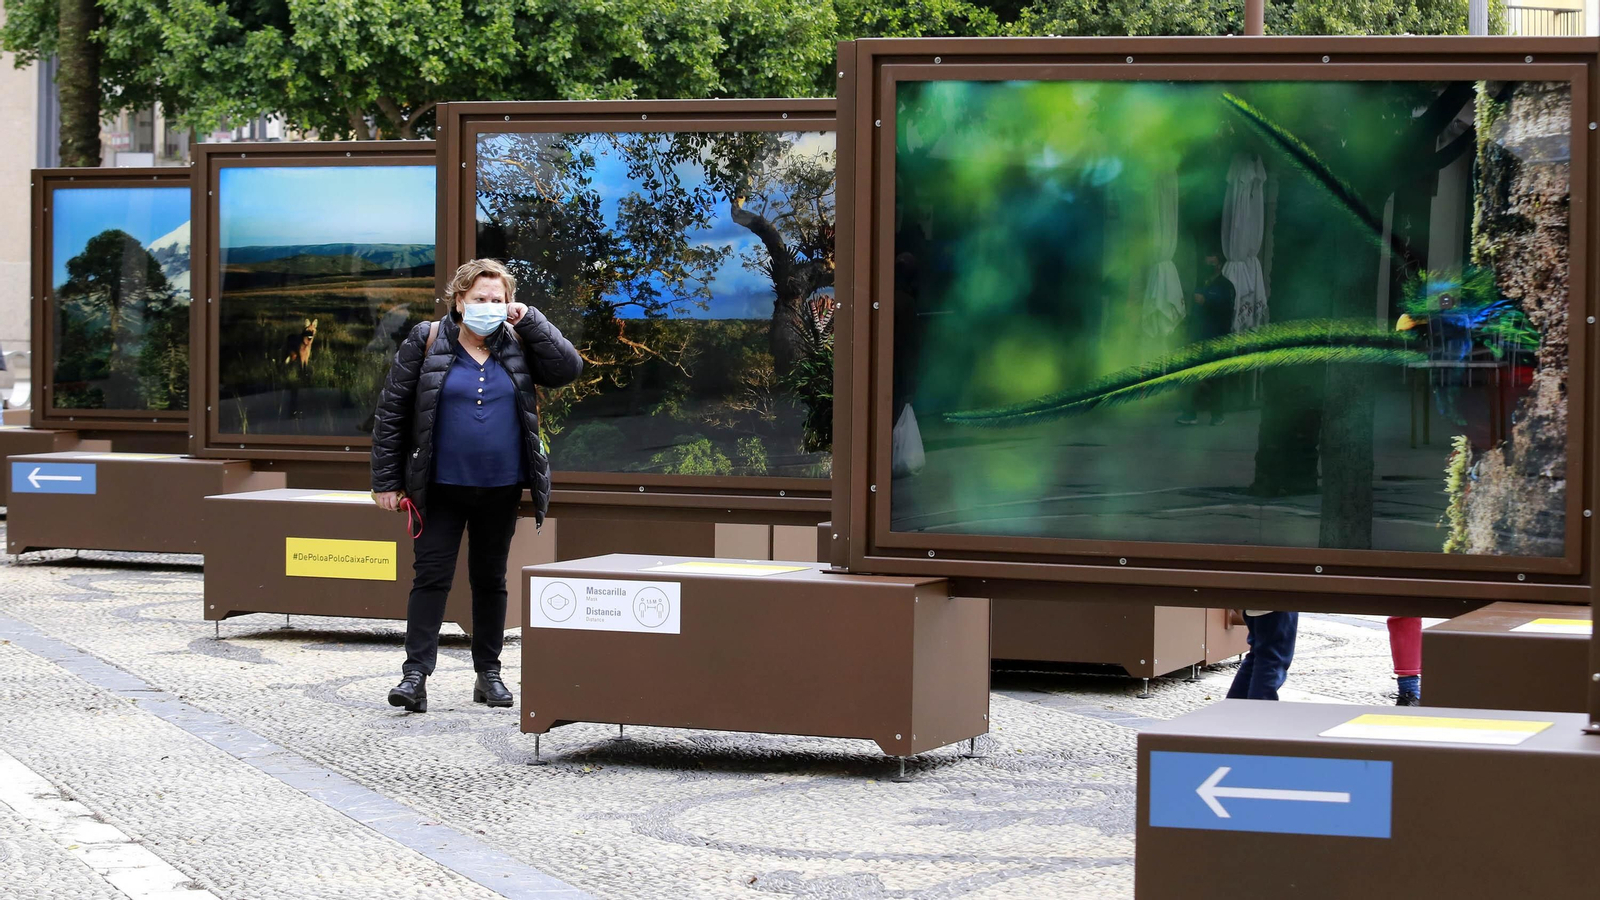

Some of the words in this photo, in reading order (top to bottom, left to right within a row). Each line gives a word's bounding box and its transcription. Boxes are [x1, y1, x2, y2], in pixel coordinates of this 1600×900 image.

[293, 552, 390, 564] #DePoloaPoloCaixaForum
[586, 586, 626, 596] Mascarilla
[586, 606, 621, 616] Distancia
